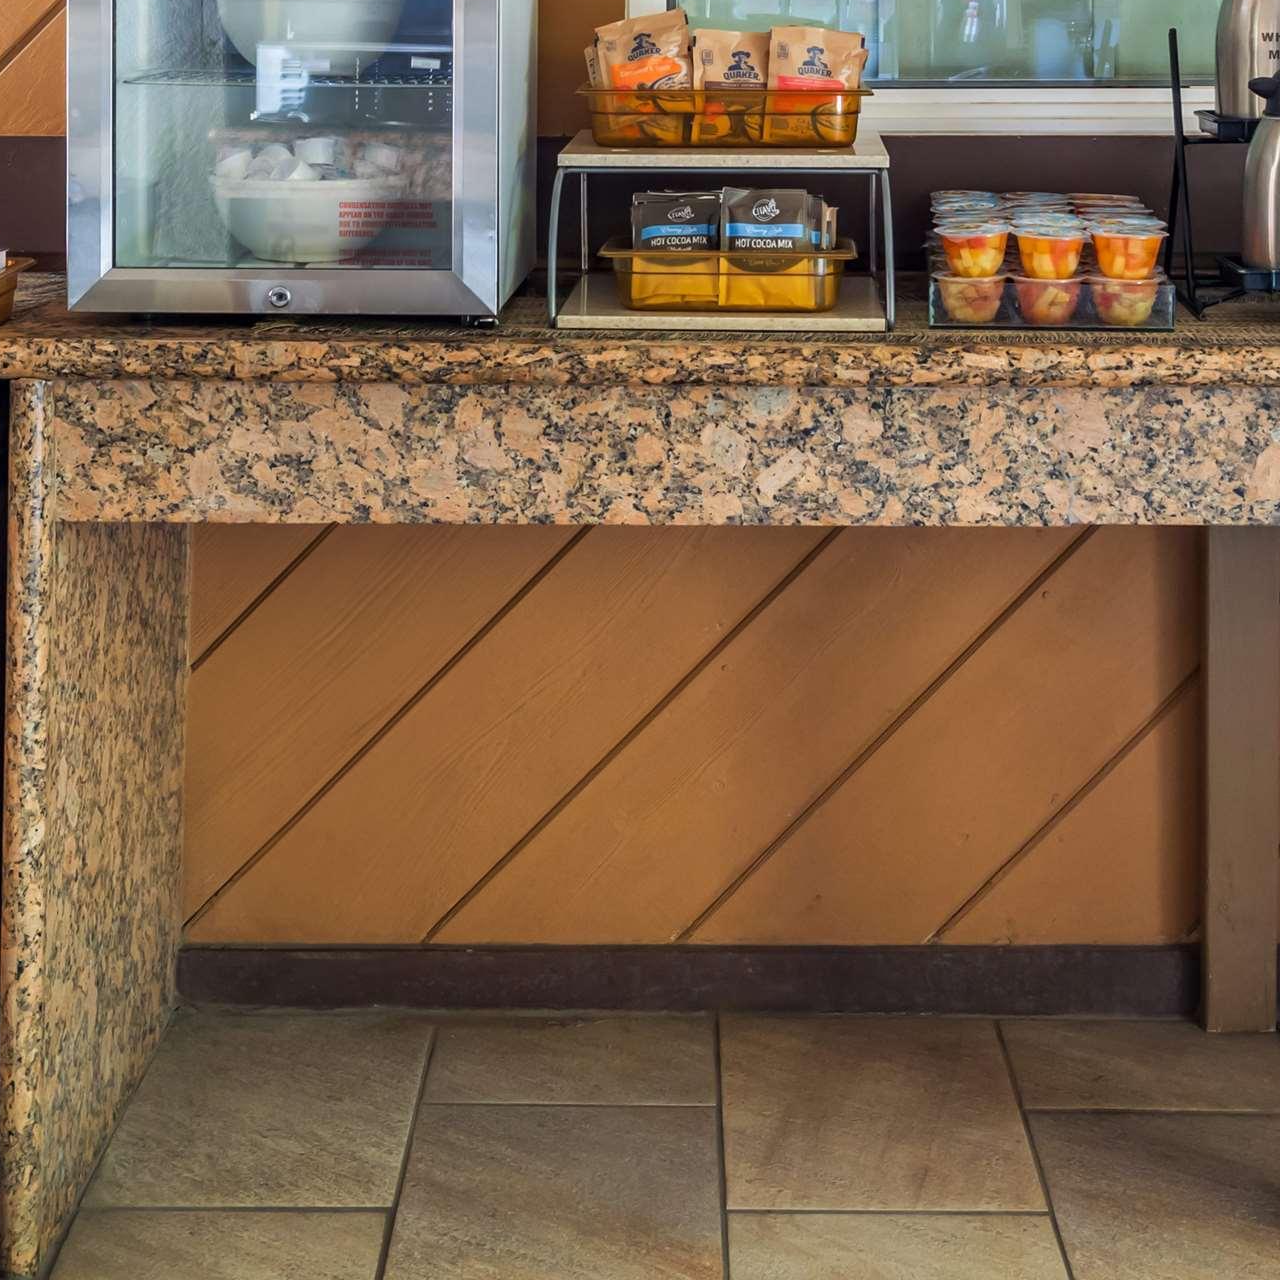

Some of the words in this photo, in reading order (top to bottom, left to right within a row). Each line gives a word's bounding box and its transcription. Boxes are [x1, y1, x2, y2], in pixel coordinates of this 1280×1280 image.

[627, 47, 662, 62] QUAKER
[723, 69, 760, 81] QUAKER
[797, 65, 833, 79] QUAKER
[651, 237, 665, 246] HOT
[666, 236, 692, 246] COCOA
[692, 236, 707, 245] MIX
[735, 238, 750, 248] HOT
[751, 239, 777, 249] COCOA
[777, 239, 793, 249] MIX
